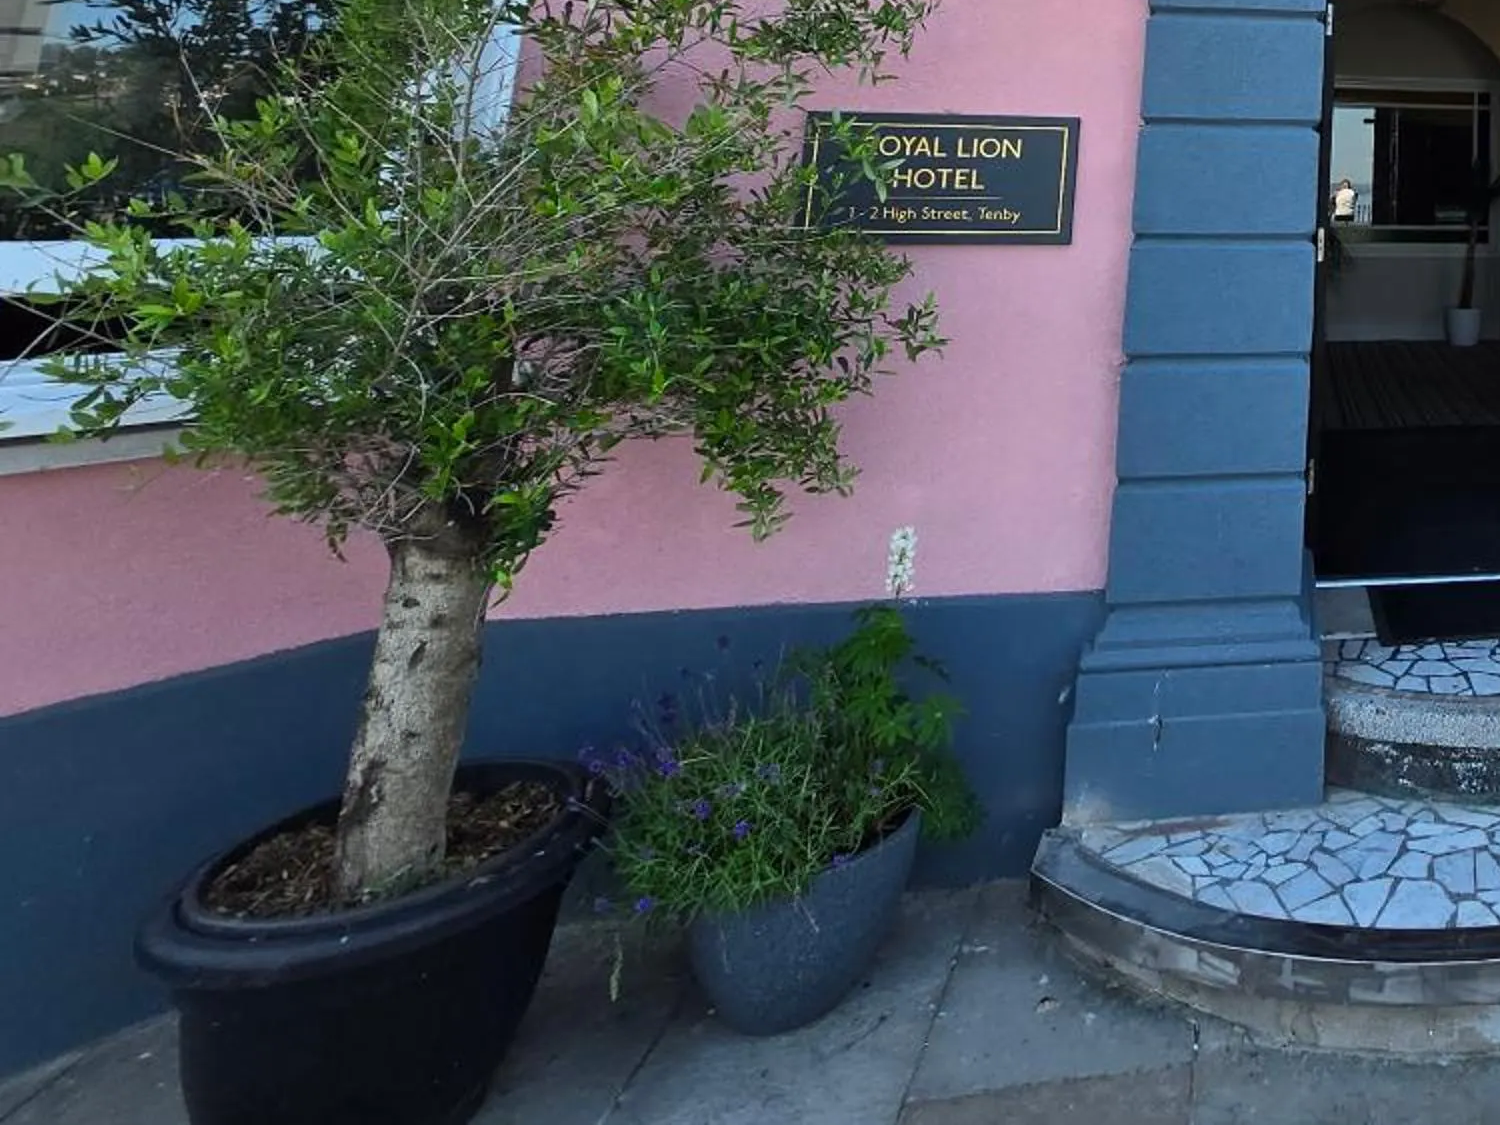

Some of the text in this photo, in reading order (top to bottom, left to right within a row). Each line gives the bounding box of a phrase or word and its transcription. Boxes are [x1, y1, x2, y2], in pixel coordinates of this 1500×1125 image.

[864, 135, 1023, 159] OYAL LION
[892, 168, 985, 190] HOTEL
[869, 206, 879, 220] 2
[883, 206, 917, 224] High
[921, 206, 972, 221] Street,
[978, 207, 1021, 224] Tenby
